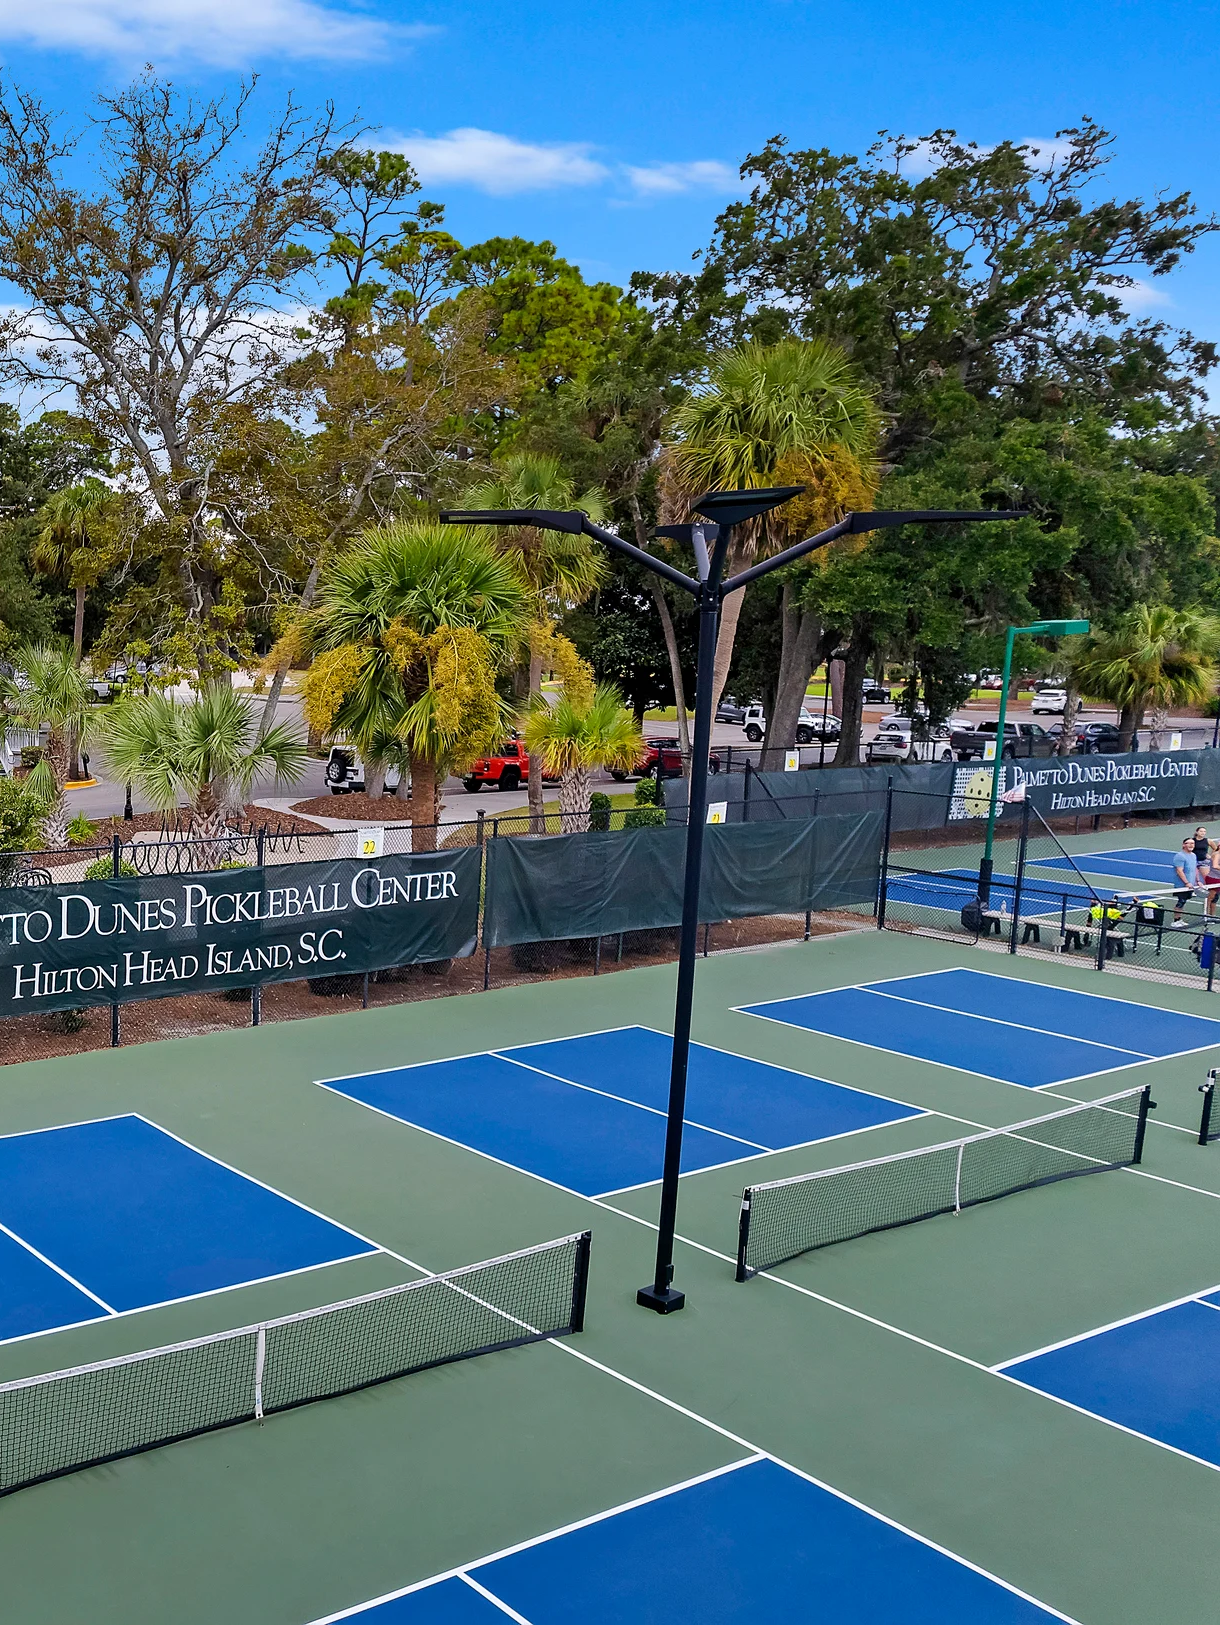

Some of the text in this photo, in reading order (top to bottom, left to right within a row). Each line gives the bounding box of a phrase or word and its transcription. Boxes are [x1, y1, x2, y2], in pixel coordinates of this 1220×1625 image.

[1013, 757, 1198, 787] PALMETTO DUNES PICKLEBALL CENTER
[1051, 792, 1085, 810] HILTON
[1085, 790, 1110, 807] HEAD
[363, 841, 375, 854] 22
[58, 894, 177, 941] DUNES
[182, 883, 348, 928] PICKLEBALL
[351, 868, 459, 909] CENTER
[12, 929, 347, 999] HILTON HEAD ISLAND, S.C.
